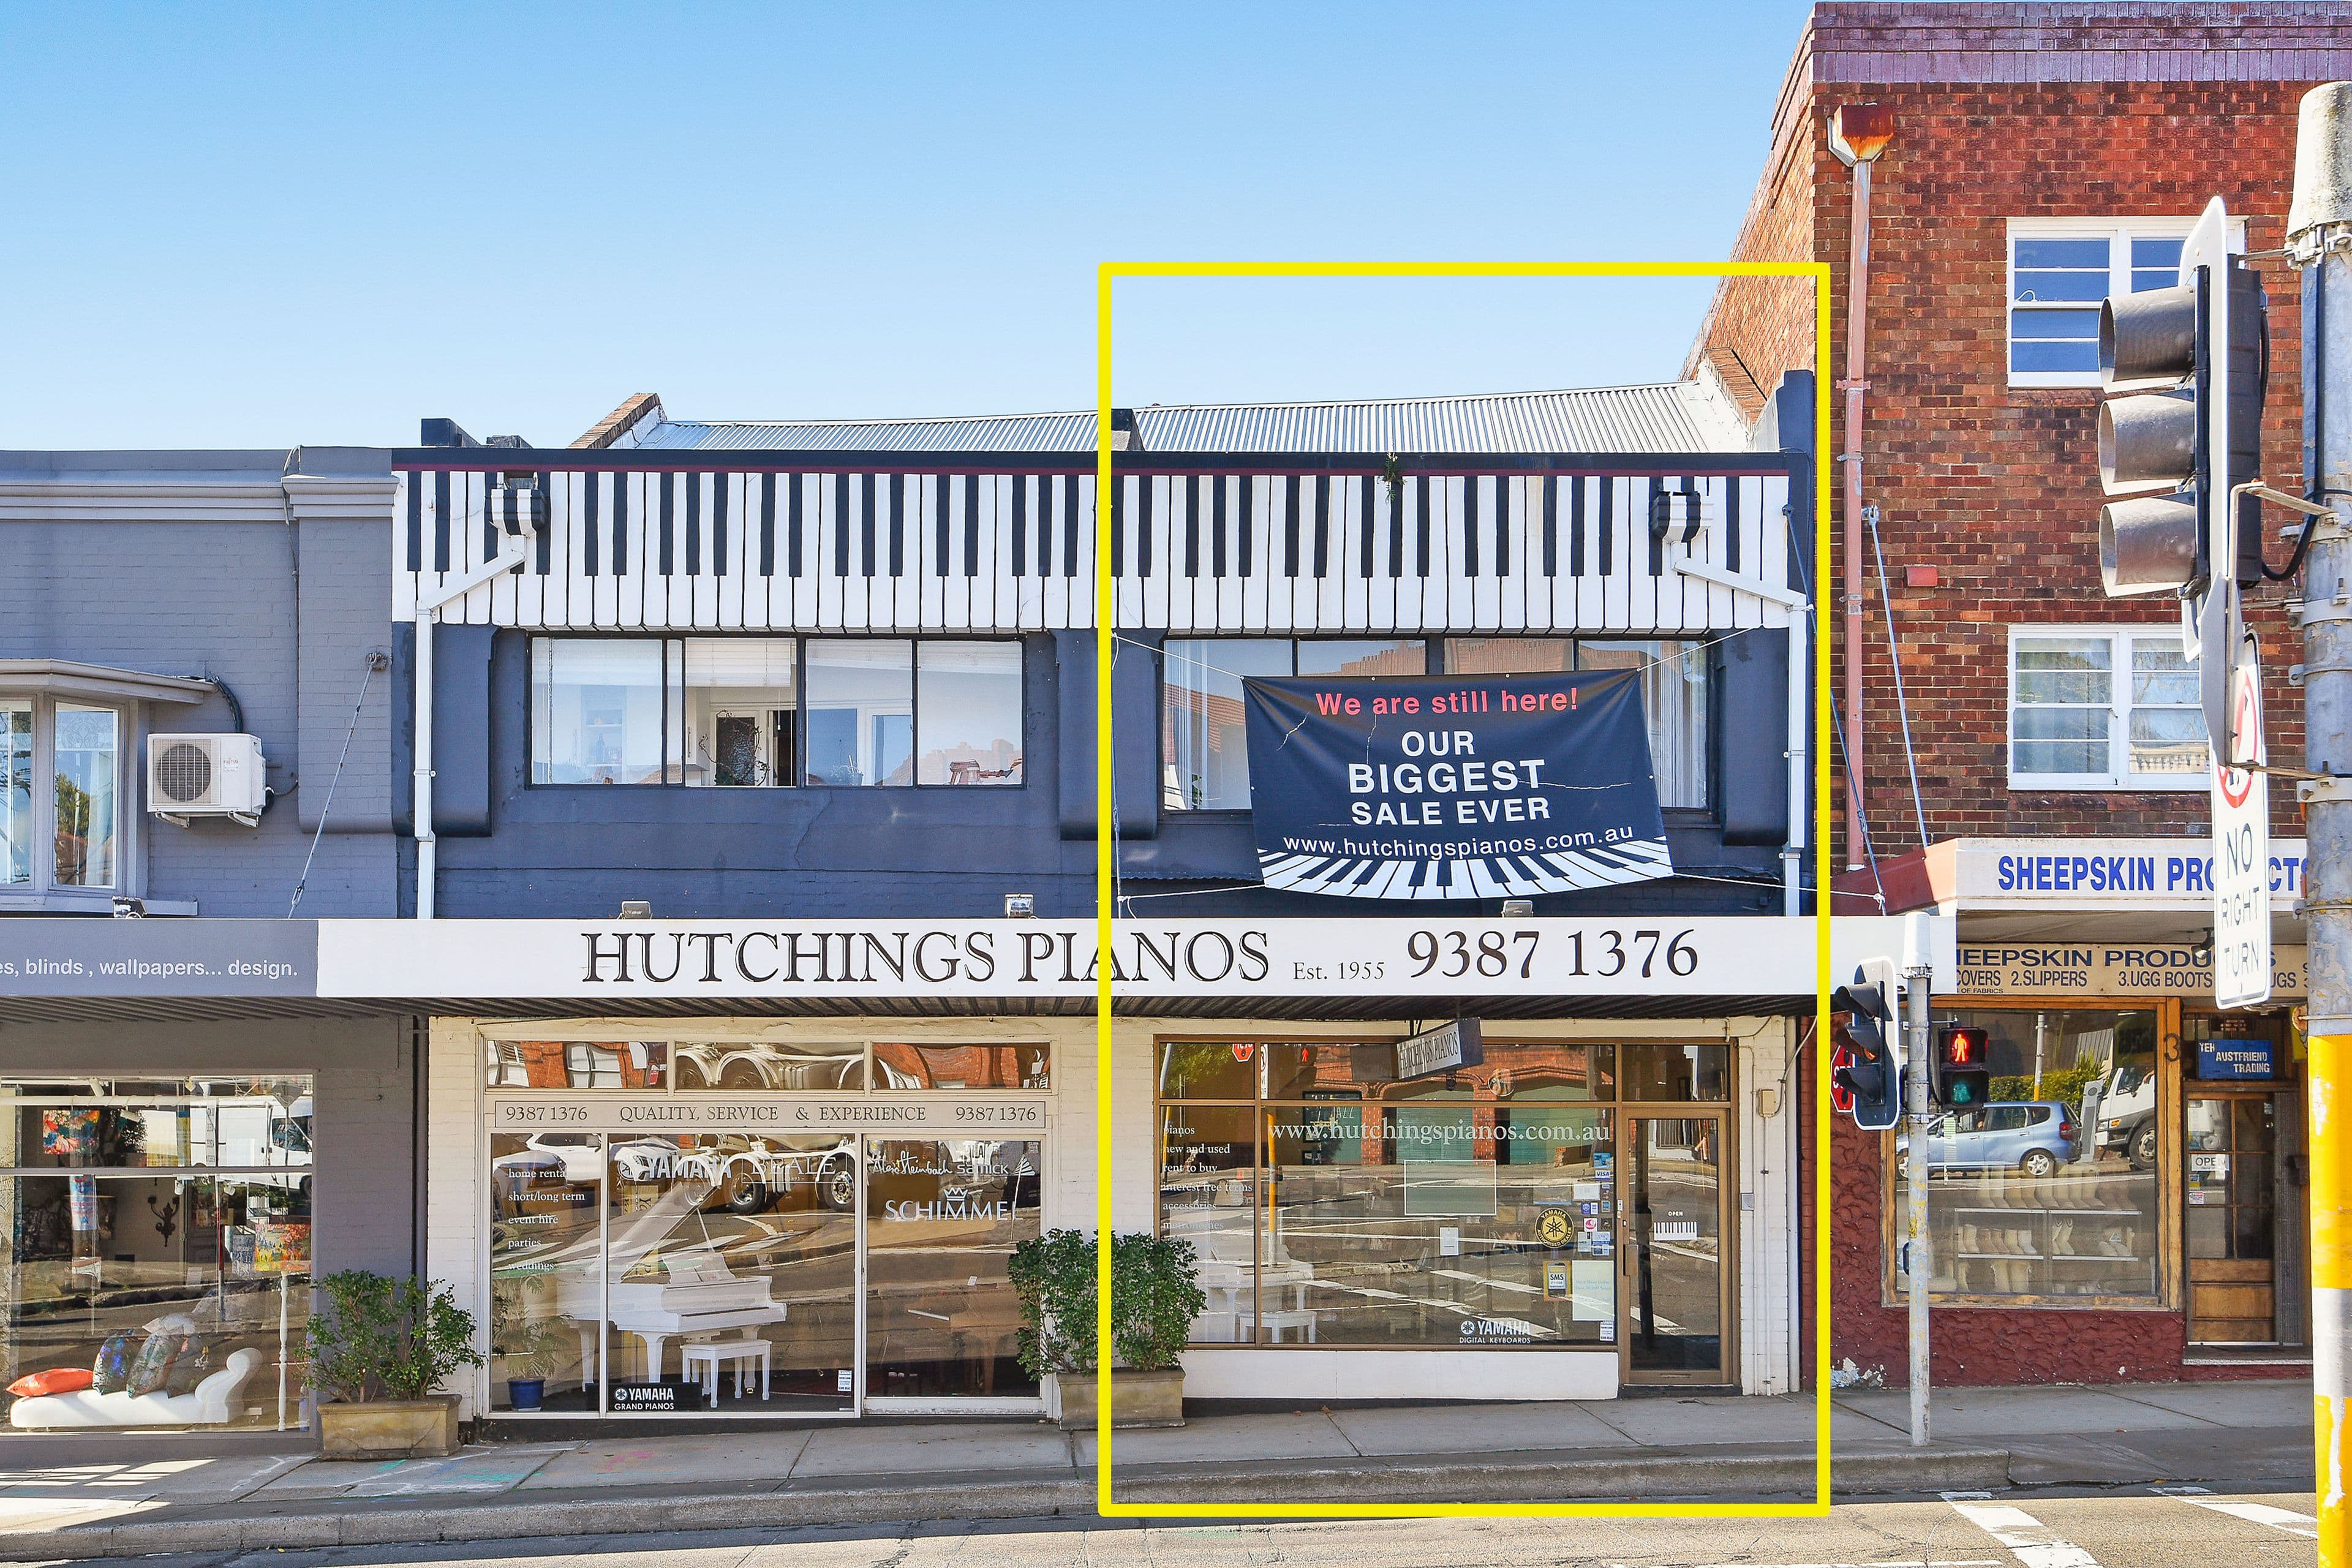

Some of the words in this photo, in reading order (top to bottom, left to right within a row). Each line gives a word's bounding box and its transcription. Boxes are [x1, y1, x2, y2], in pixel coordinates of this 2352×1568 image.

[1316, 692, 1361, 716] We
[1373, 695, 1420, 715] are
[1431, 690, 1488, 714] still
[1501, 687, 1578, 712] here!
[1401, 730, 1475, 757] OUR
[1349, 759, 1545, 794] BIGGEST
[1351, 800, 1442, 826] SALE
[1457, 797, 1550, 825] EVER
[1283, 826, 1634, 861] www.hutchingspianos.com.au
[2226, 823, 2253, 879] NO
[1998, 855, 2154, 891] SHEEPSKIN
[2221, 886, 2260, 930] RIGHT
[581, 931, 995, 982] HUTCHINGS
[1016, 931, 1269, 982] PIANOS
[1293, 962, 1328, 980] Est.
[1337, 961, 1385, 980] 1955
[1408, 930, 1539, 979] 9387
[1568, 929, 1698, 978] 1376
[2223, 939, 2260, 978] TURN
[26, 958, 84, 975] blinds
[99, 959, 222, 979] wallpapers...
[228, 959, 298, 980] design.
[2011, 970, 2087, 987] 2.SLIPPERS
[2118, 971, 2161, 987] 3.UGG
[2165, 971, 2212, 988] BOOTS
[1434, 1031, 1458, 1061] PIANOS
[2164, 1033, 2180, 1061] 3
[2199, 1042, 2215, 1052] YEH
[2215, 1052, 2267, 1061] AUSTFRIEND
[2233, 1063, 2270, 1073] TRADING
[507, 1107, 545, 1120] 9387
[551, 1107, 588, 1120] 1376
[620, 1106, 699, 1122] QUALITY,
[707, 1106, 778, 1120] SERVICE
[796, 1106, 809, 1120] &
[820, 1106, 926, 1121] EXPERIENCE
[956, 1106, 994, 1121] 9387
[1000, 1106, 1036, 1121] 1376
[1267, 1117, 1611, 1145] www.hutchingspianos.com.au
[1186, 1143, 1205, 1153] and
[1207, 1143, 1231, 1153] used
[647, 1155, 733, 1178] YAMAHA
[1164, 1164, 1185, 1172] rent
[1186, 1164, 1197, 1172] to
[1199, 1162, 1218, 1174] buy
[2195, 1156, 2222, 1166] OPE
[508, 1168, 537, 1178] home
[508, 1191, 559, 1203] short/long
[562, 1193, 585, 1201] term
[508, 1216, 535, 1224] event
[539, 1213, 559, 1224] hire
[884, 1199, 1024, 1221] SCHIMMEL
[1540, 1210, 1566, 1219] YAMAHA
[508, 1237, 541, 1250] parties
[1477, 1321, 1531, 1335] YAMAHA
[628, 1388, 674, 1401] YAMAHA
